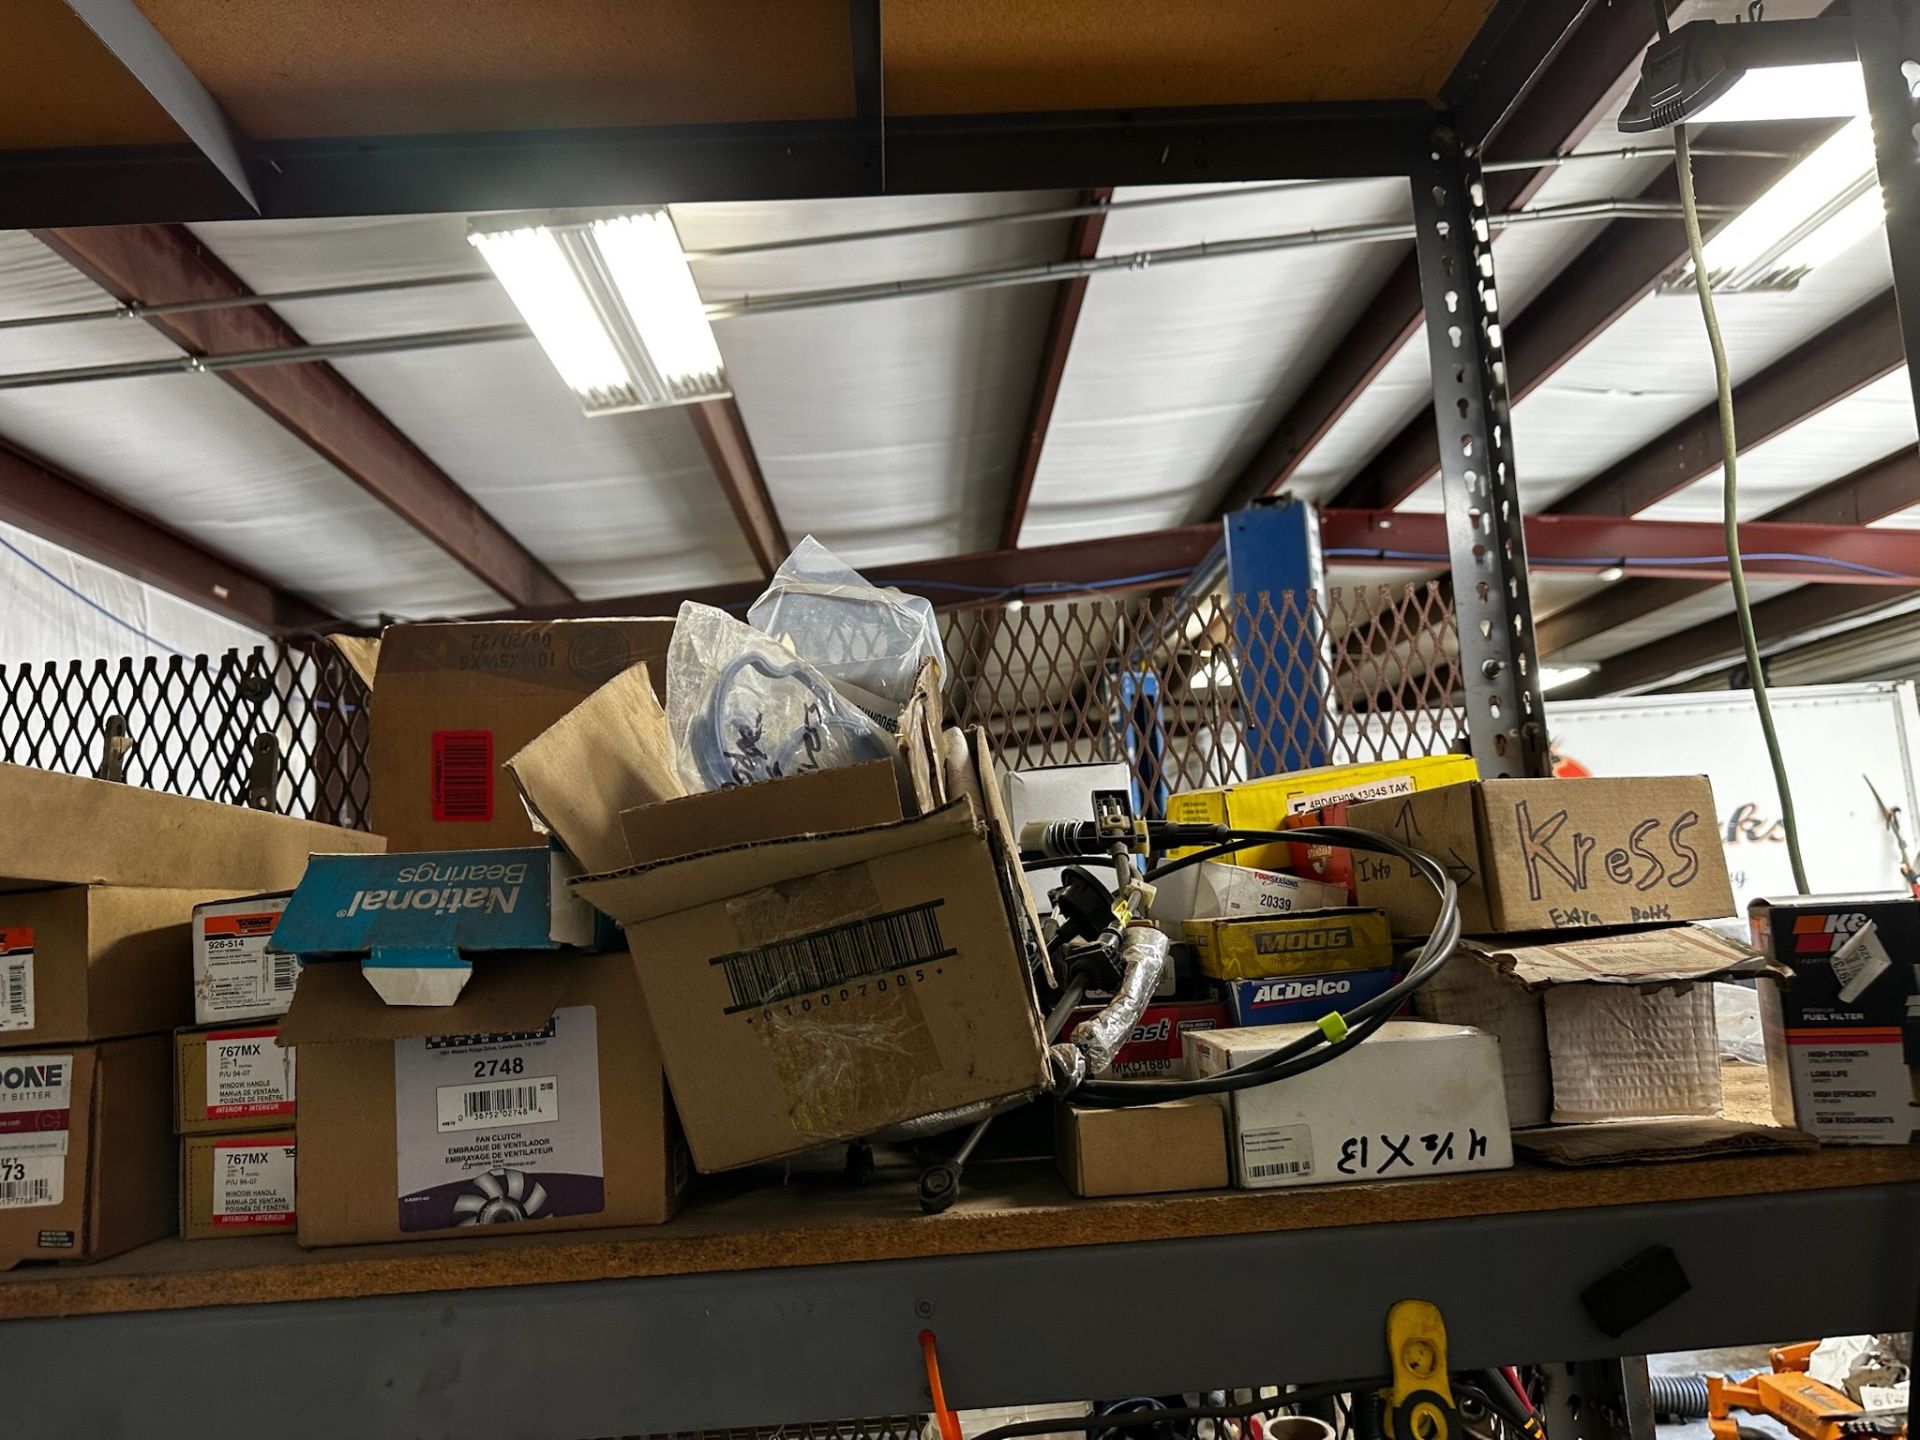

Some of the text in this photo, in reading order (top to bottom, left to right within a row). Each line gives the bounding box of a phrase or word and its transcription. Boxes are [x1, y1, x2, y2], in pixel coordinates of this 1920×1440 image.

[1389, 782, 1408, 794] TAK
[397, 862, 528, 886] Bearings
[346, 887, 521, 918] National
[1260, 894, 1291, 911] 20339
[208, 939, 244, 949] 926-514
[1259, 929, 1348, 953] MOOG
[1252, 979, 1351, 1003] ACDelco
[1803, 1012, 1864, 1021] FUEL FILTER
[426, 1031, 555, 1049] AUTOMOTIVE
[219, 1044, 261, 1057] 767MX
[232, 1058, 237, 1067] 1
[473, 1057, 524, 1078] 2748
[1111, 1059, 1171, 1073] MKD1680
[0, 1064, 63, 1090] ONE
[11, 1091, 51, 1101] BETTER
[474, 1111, 499, 1120] 36752
[502, 1109, 528, 1117] 02748
[475, 1132, 521, 1143] FAN CLUTCH
[502, 1138, 550, 1149] VENTILADOR
[1468, 1128, 1487, 1161] 4
[226, 1152, 268, 1165] 767MX
[445, 1153, 490, 1164] EMBRAYAGE
[492, 1152, 502, 1160] DE
[504, 1146, 553, 1158] VENTILATEUR
[1337, 1136, 1368, 1174] 13
[1376, 1134, 1414, 1174] X
[239, 1166, 244, 1175] 1
[1302, 1160, 1310, 1170] US
